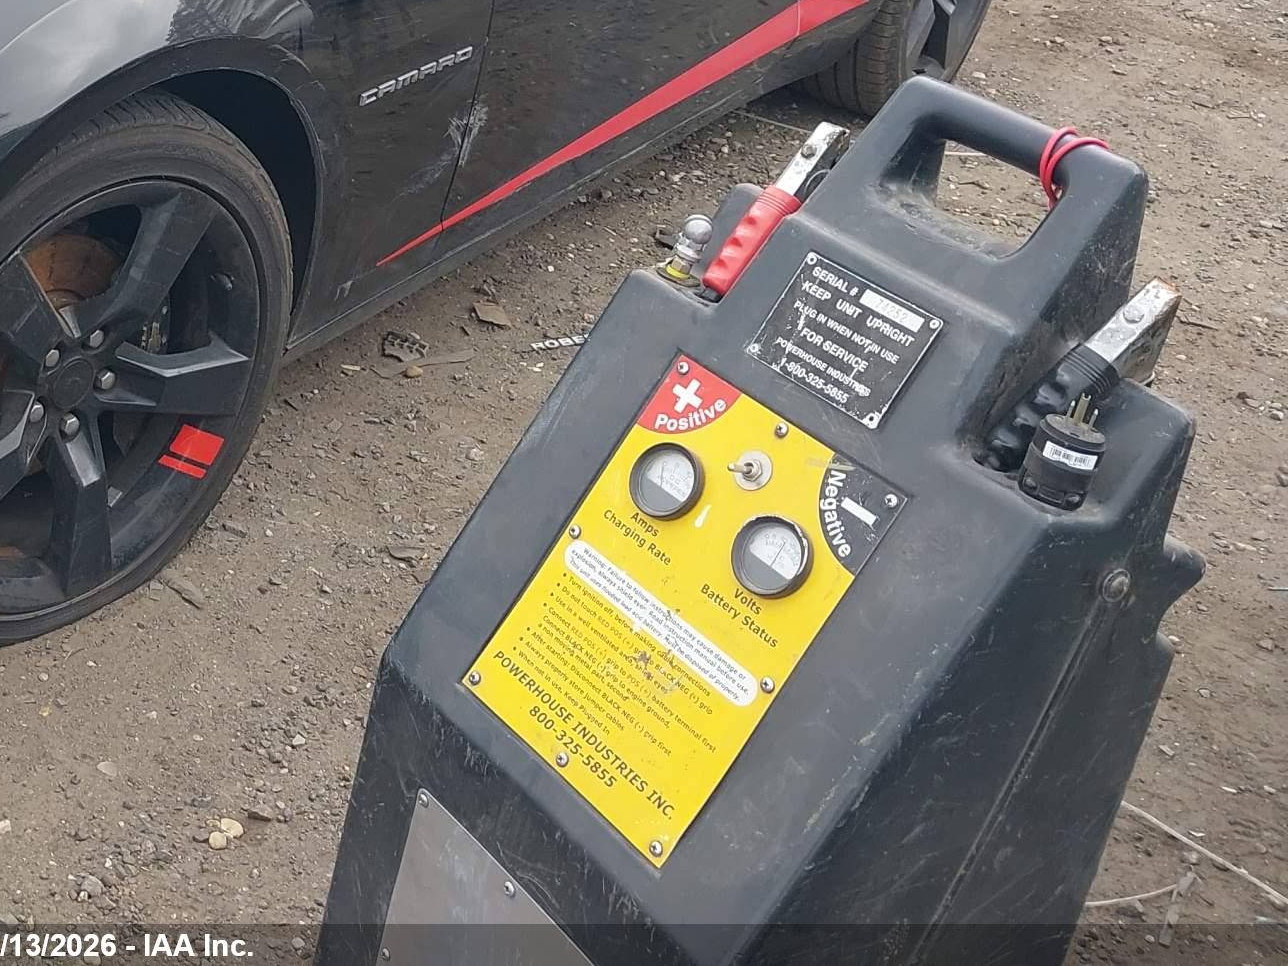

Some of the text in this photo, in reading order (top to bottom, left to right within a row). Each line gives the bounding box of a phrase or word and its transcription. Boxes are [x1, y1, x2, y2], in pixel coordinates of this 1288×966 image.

[360, 46, 473, 106] CAMARO
[810, 265, 851, 293] SERIAL
[848, 285, 860, 297] #
[530, 333, 589, 351] ROBE
[792, 299, 900, 364] PLUG IN WHEN NOT IN USE
[800, 279, 915, 348] KEEP UNIT UPRIGHT
[775, 335, 828, 371] POWERHOUSE
[799, 326, 869, 372] FOR SERVICE
[779, 356, 849, 404] 1-800-325-5855
[654, 398, 728, 431] Positive
[600, 507, 673, 566] Charging Rate
[628, 510, 661, 539] Amps
[819, 470, 852, 558] Negative
[554, 595, 566, 607] Use
[577, 614, 591, 627] well
[589, 624, 620, 652] ventilated
[567, 575, 582, 590] Turn
[580, 586, 604, 609] ignition
[613, 613, 634, 633] before
[632, 630, 657, 652] making
[698, 582, 780, 648] Battery Status
[731, 587, 763, 615] Volts
[541, 614, 566, 637] Connect
[564, 633, 584, 653] BLACK
[583, 649, 597, 664] NEG
[604, 668, 619, 684] grip
[624, 686, 647, 708] engine
[645, 704, 672, 729] ground,
[542, 626, 554, 638] non
[552, 635, 575, 657] moving
[574, 653, 592, 670] metal
[561, 586, 570, 596] Do
[569, 592, 580, 604] not
[579, 601, 597, 618] touch
[596, 615, 610, 628] RED
[608, 625, 623, 639] POS
[674, 679, 690, 695] NEG
[698, 700, 714, 716] grip
[681, 628, 696, 642] may
[695, 638, 714, 655] cause
[712, 652, 739, 675] damage
[737, 672, 747, 681] or
[693, 647, 717, 668] manual
[715, 665, 737, 684] before
[517, 650, 535, 667] When
[533, 664, 544, 676] not
[562, 690, 579, 708] Keep
[577, 704, 603, 729] Plugged
[523, 640, 545, 661] Always
[568, 678, 585, 695] store
[583, 692, 605, 713] jumper
[604, 710, 625, 731] cables
[530, 630, 546, 646] After
[569, 664, 602, 694] Disconnect
[600, 692, 621, 712] BLACK
[620, 709, 635, 724] NEG
[642, 729, 658, 745] grip
[656, 741, 672, 757] first
[547, 606, 571, 629] Connect
[569, 625, 584, 639] RED
[582, 635, 596, 650] POS
[605, 656, 620, 671] grip
[625, 672, 641, 687] POS
[649, 694, 674, 718] battery
[673, 714, 702, 740] terminal
[700, 736, 717, 753] first
[492, 648, 677, 821] POWERHOUSE INDUSTRIES INC.
[527, 703, 618, 789] 800-325-5855
